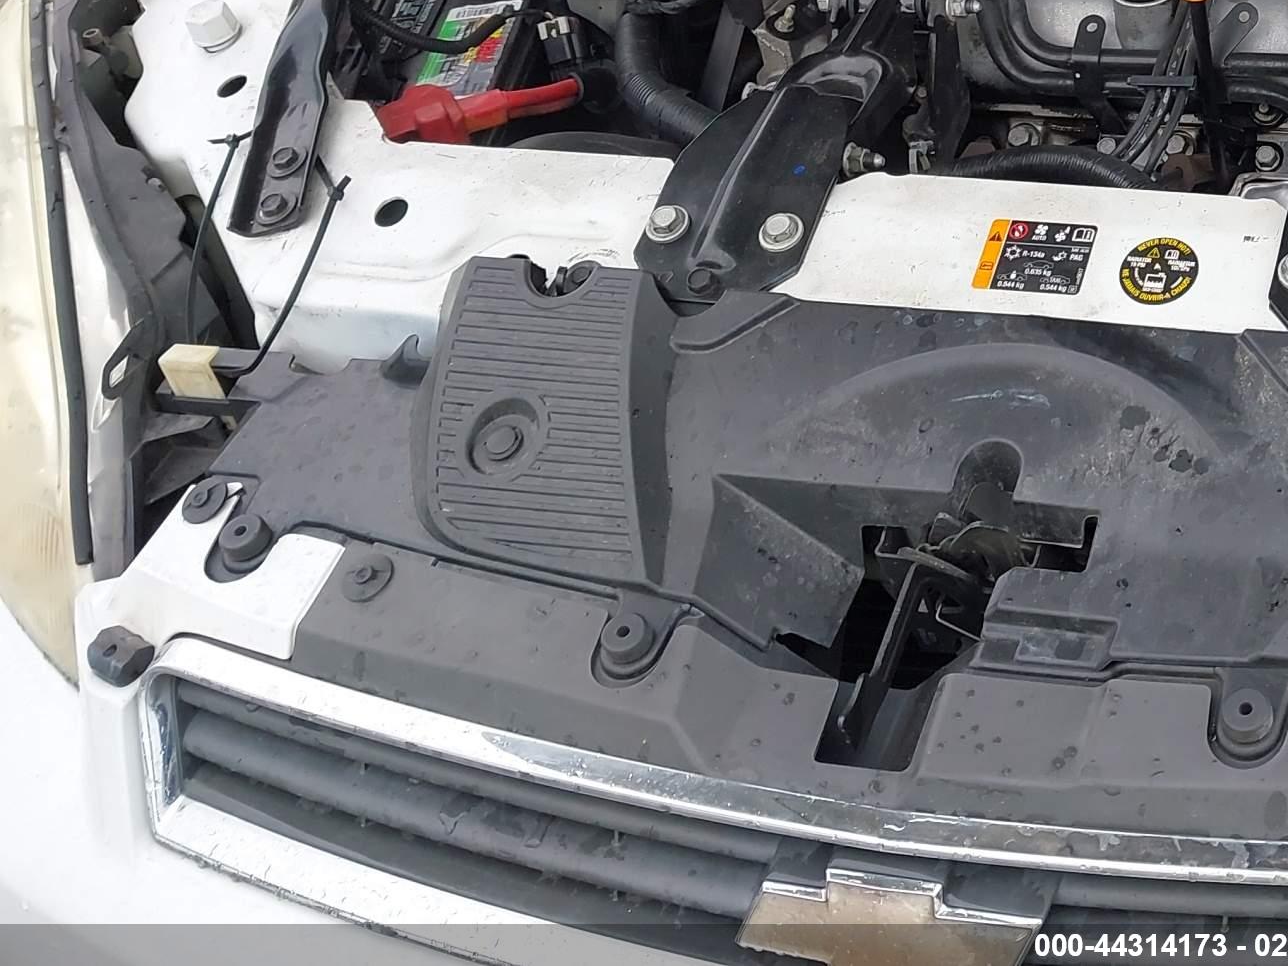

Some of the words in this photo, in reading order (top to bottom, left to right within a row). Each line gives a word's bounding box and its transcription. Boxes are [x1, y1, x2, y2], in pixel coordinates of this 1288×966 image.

[1137, 238, 1160, 251] NEVER
[1160, 238, 1179, 247] OPEN
[1022, 250, 1045, 258] R-134a
[1069, 253, 1084, 261] PAG
[1043, 269, 1052, 277] kg
[1015, 281, 1025, 290] kg
[1058, 285, 1067, 293] kg
